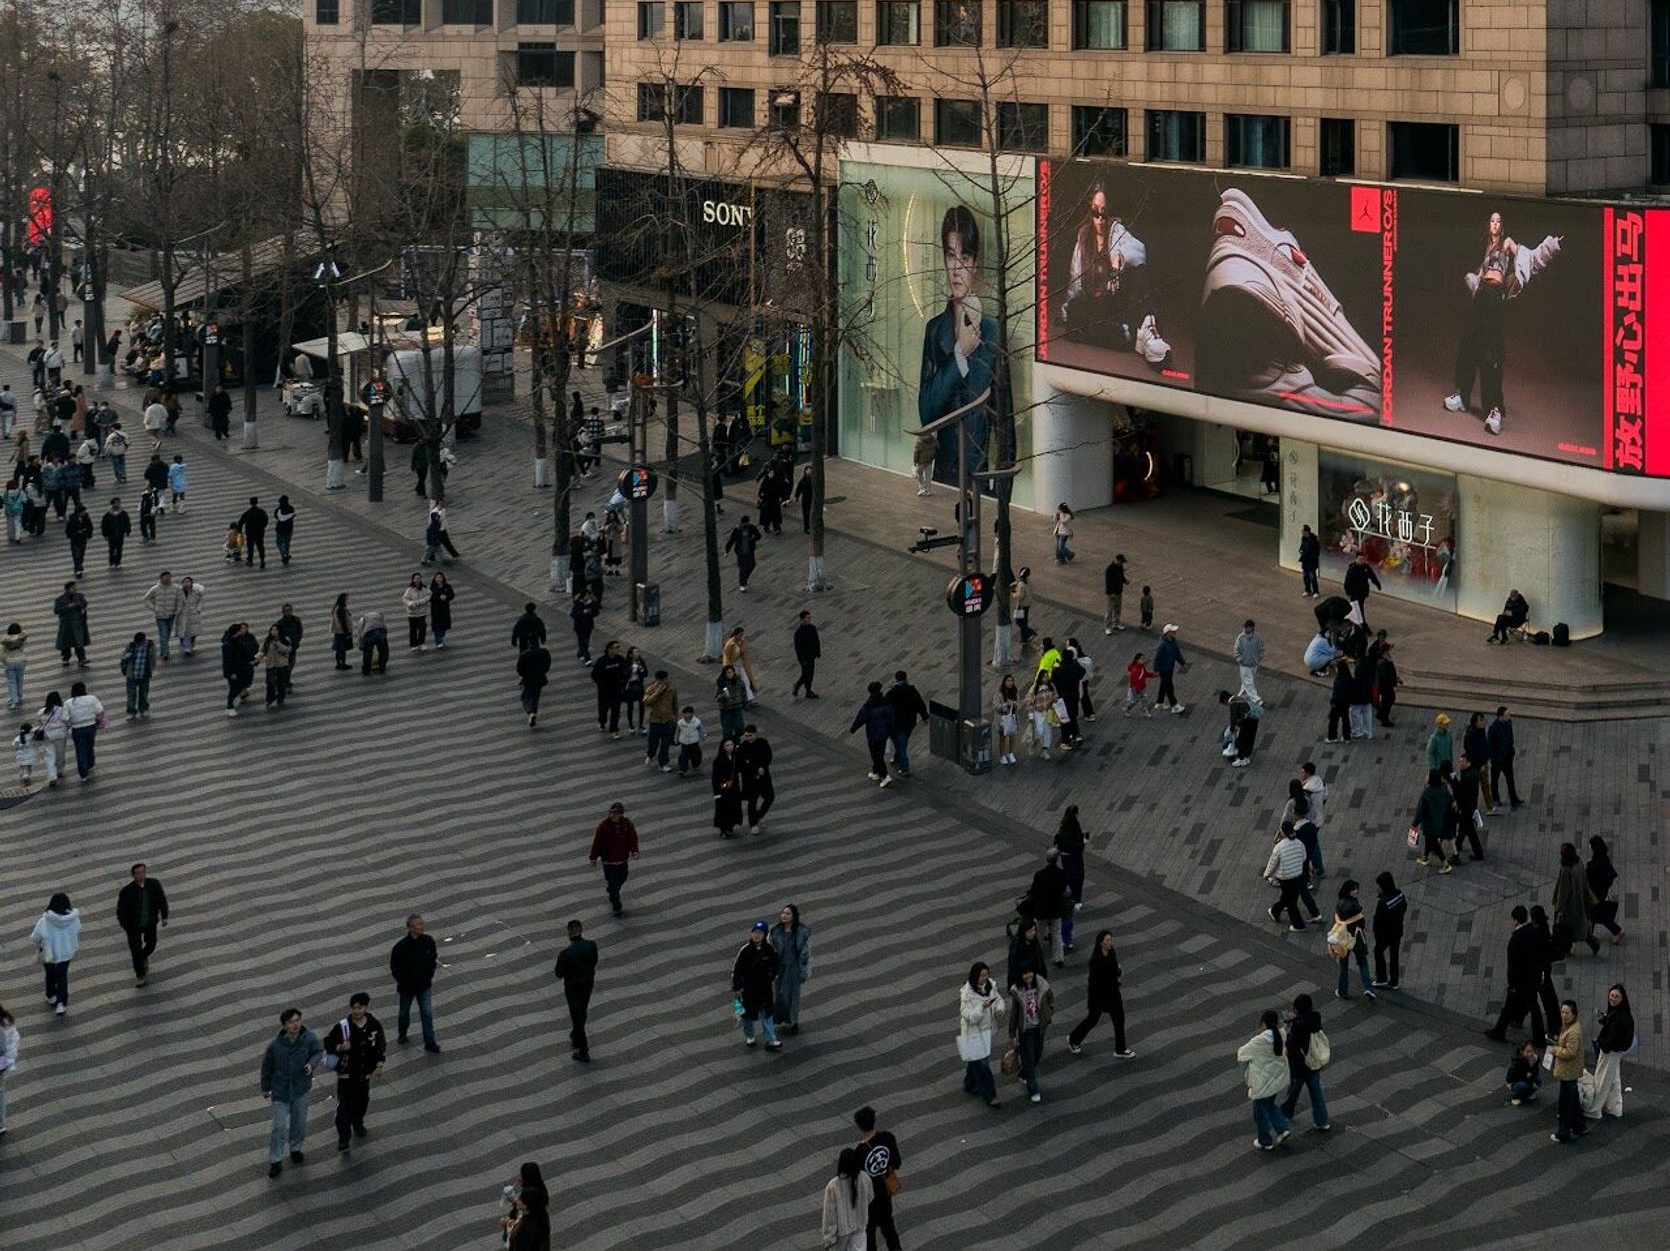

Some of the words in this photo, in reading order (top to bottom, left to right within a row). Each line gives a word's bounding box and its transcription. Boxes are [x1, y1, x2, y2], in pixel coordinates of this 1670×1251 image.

[1382, 189, 1393, 230] O/S
[1382, 231, 1393, 335] TRUNNER
[1382, 338, 1393, 426] JORDAN
[1615, 211, 1644, 470] 放野心出马
[1376, 502, 1436, 547] 花西子
